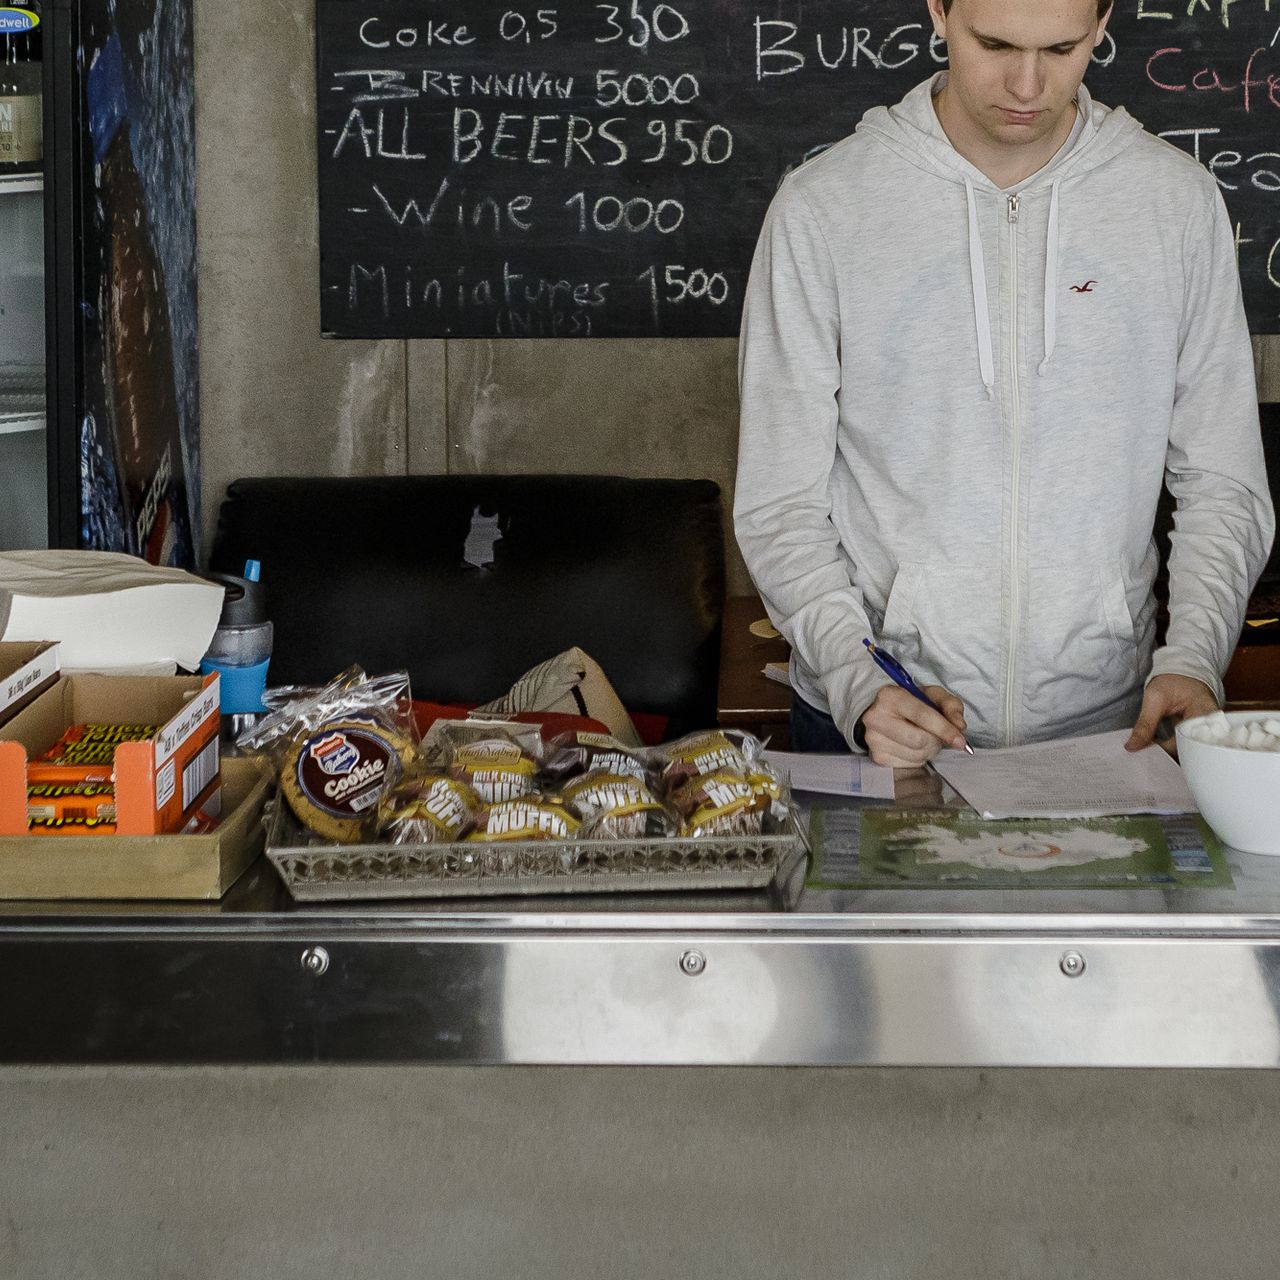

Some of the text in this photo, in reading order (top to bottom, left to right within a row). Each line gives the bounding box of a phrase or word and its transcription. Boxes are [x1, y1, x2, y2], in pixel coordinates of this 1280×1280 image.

[594, 69, 701, 107] 5000
[453, 106, 628, 169] BEERS
[642, 120, 734, 166] 950
[565, 191, 685, 234] 1000
[637, 264, 729, 331] 1500
[323, 758, 385, 798] Cookie
